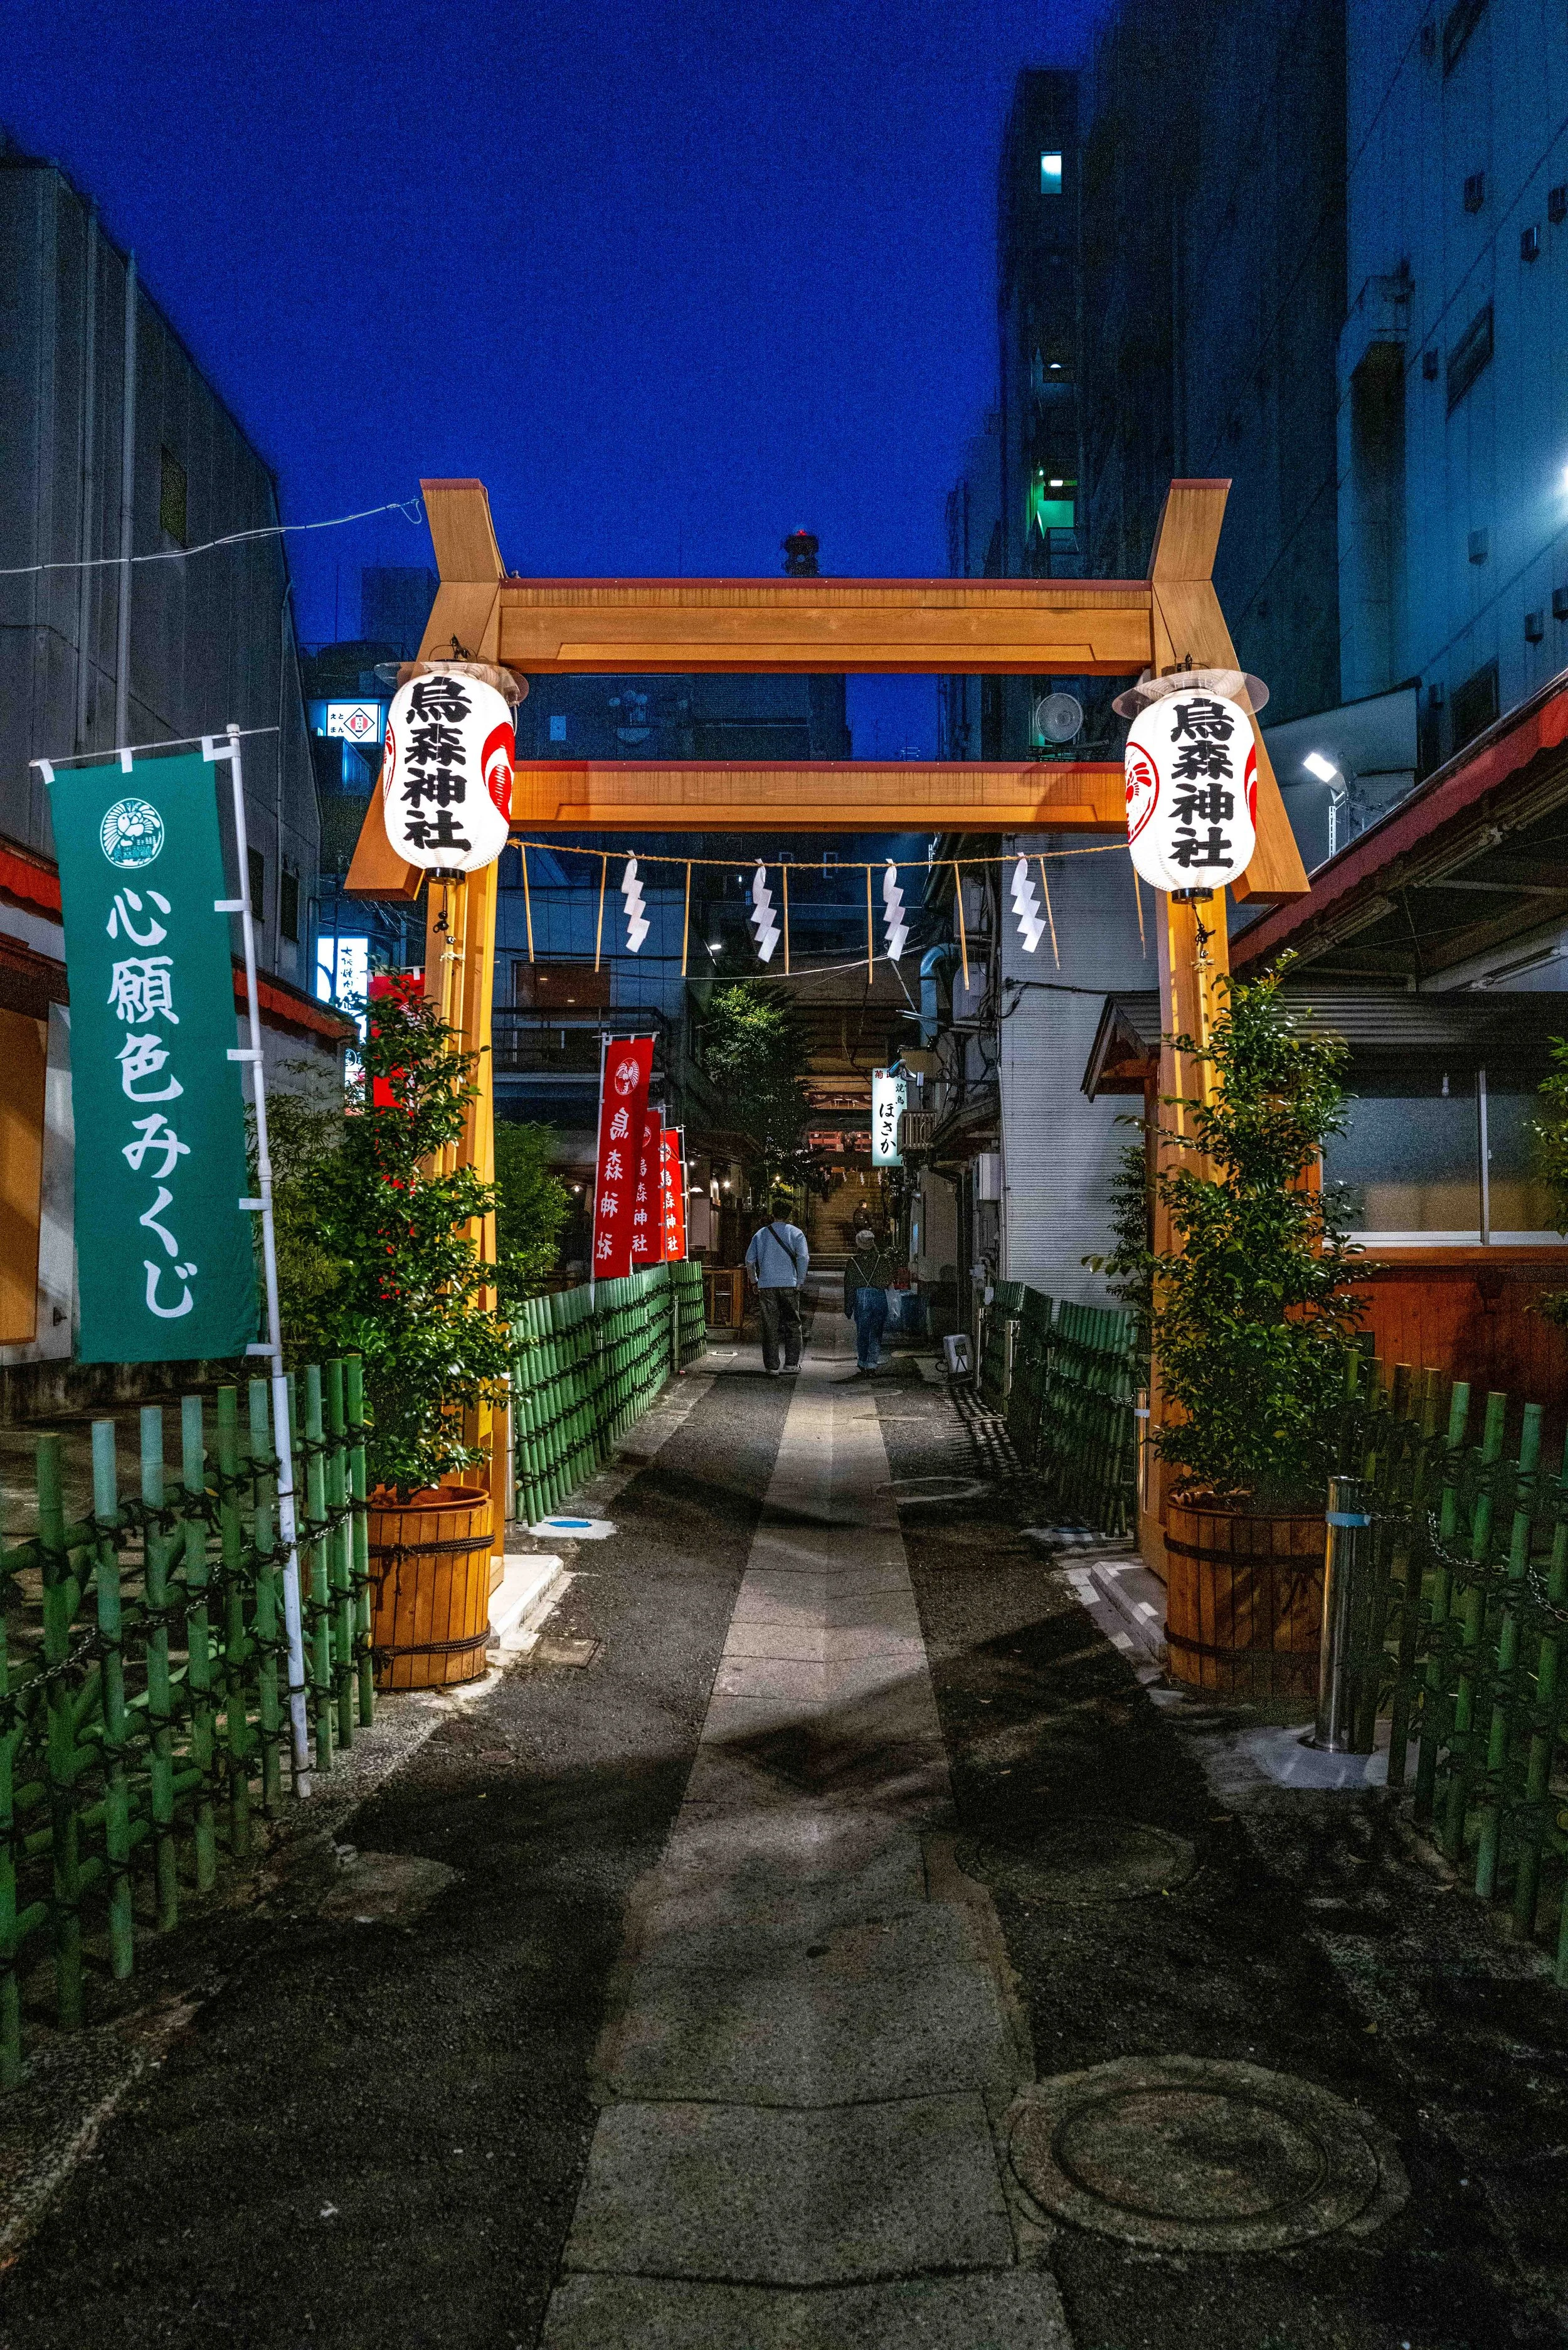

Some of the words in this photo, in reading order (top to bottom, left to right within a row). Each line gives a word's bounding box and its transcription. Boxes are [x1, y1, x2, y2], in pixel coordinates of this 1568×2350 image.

[400, 676, 472, 851] 烏森神社
[1168, 698, 1235, 868] 烏森神社
[106, 886, 198, 1319] 心願色みくじ
[879, 1103, 896, 1154] ほさか
